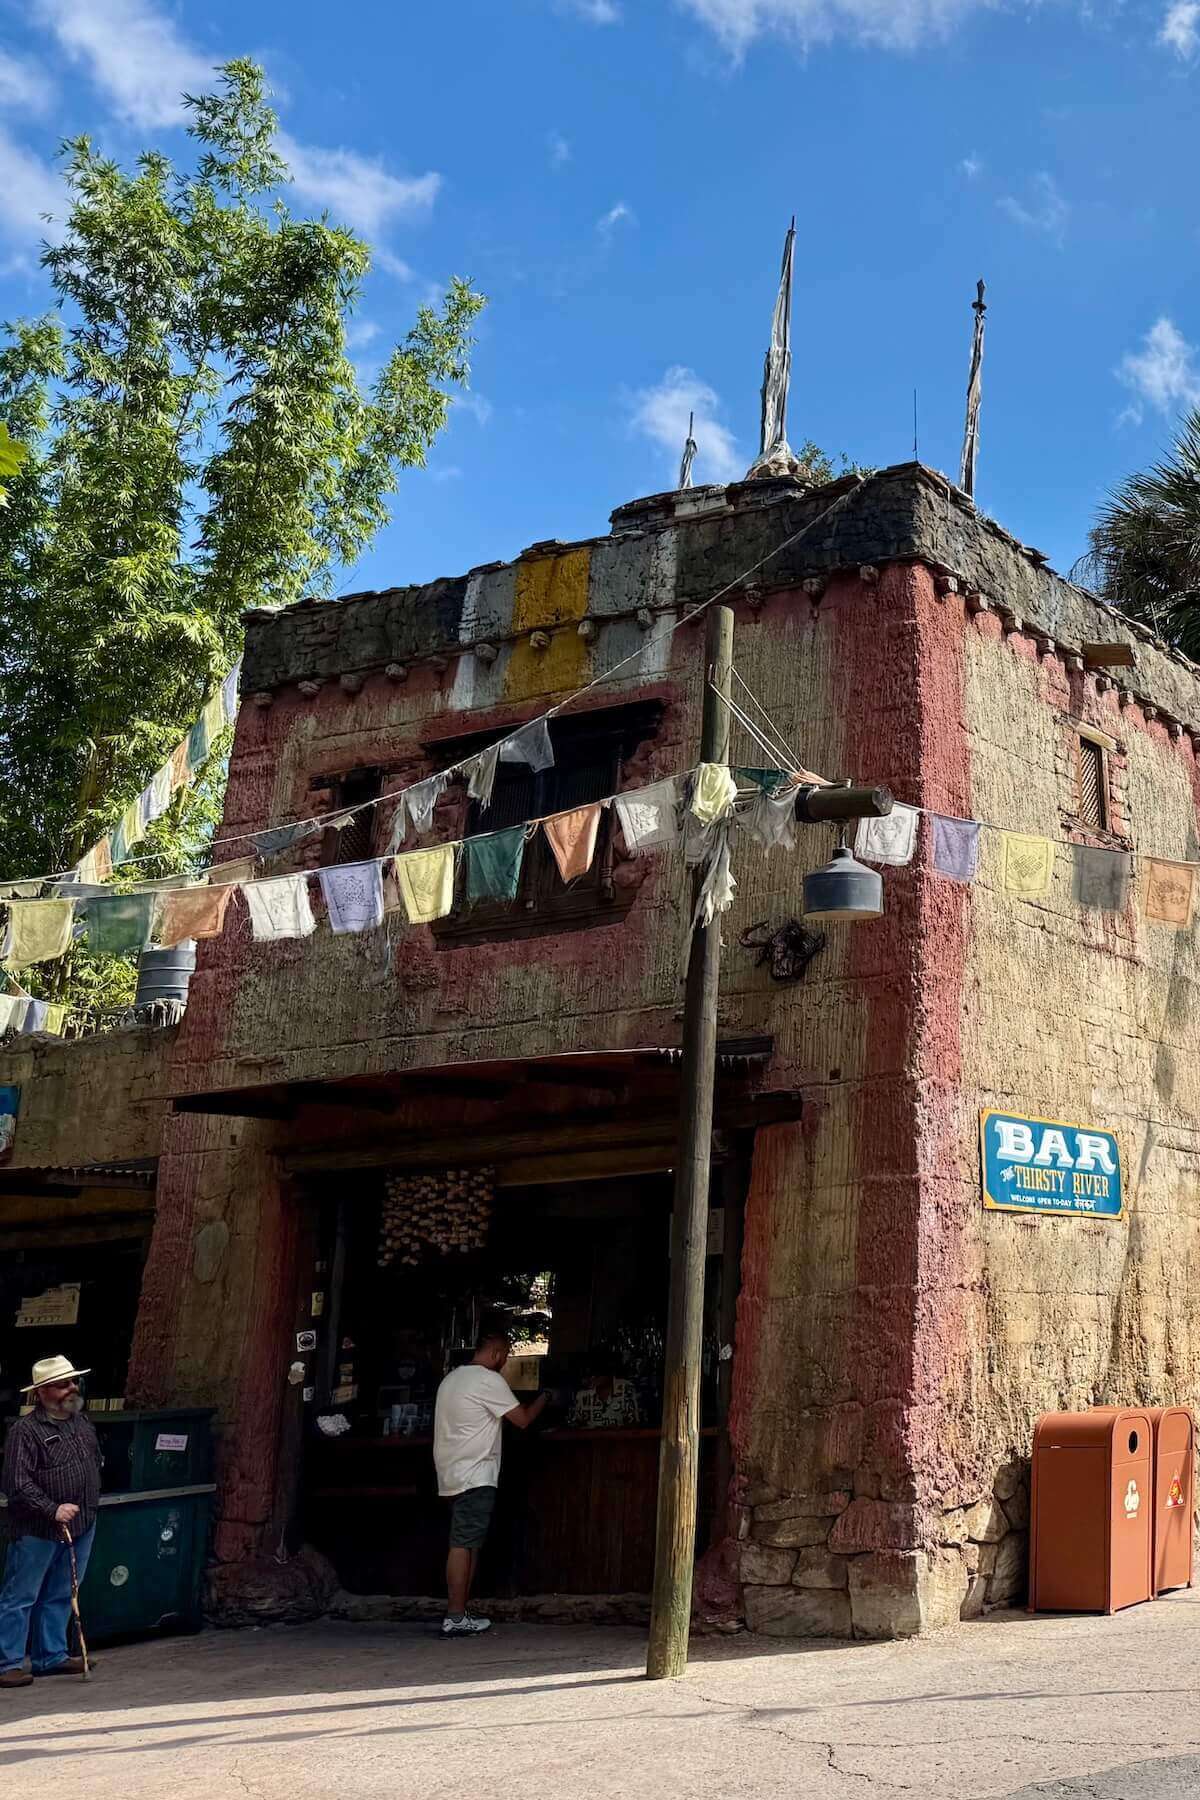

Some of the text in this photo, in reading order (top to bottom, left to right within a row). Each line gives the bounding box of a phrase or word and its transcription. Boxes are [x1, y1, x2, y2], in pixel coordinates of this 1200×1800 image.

[994, 1119, 1117, 1175] BAR
[1014, 1165, 1066, 1193] THIRSTY
[1072, 1172, 1110, 1198] RIVER
